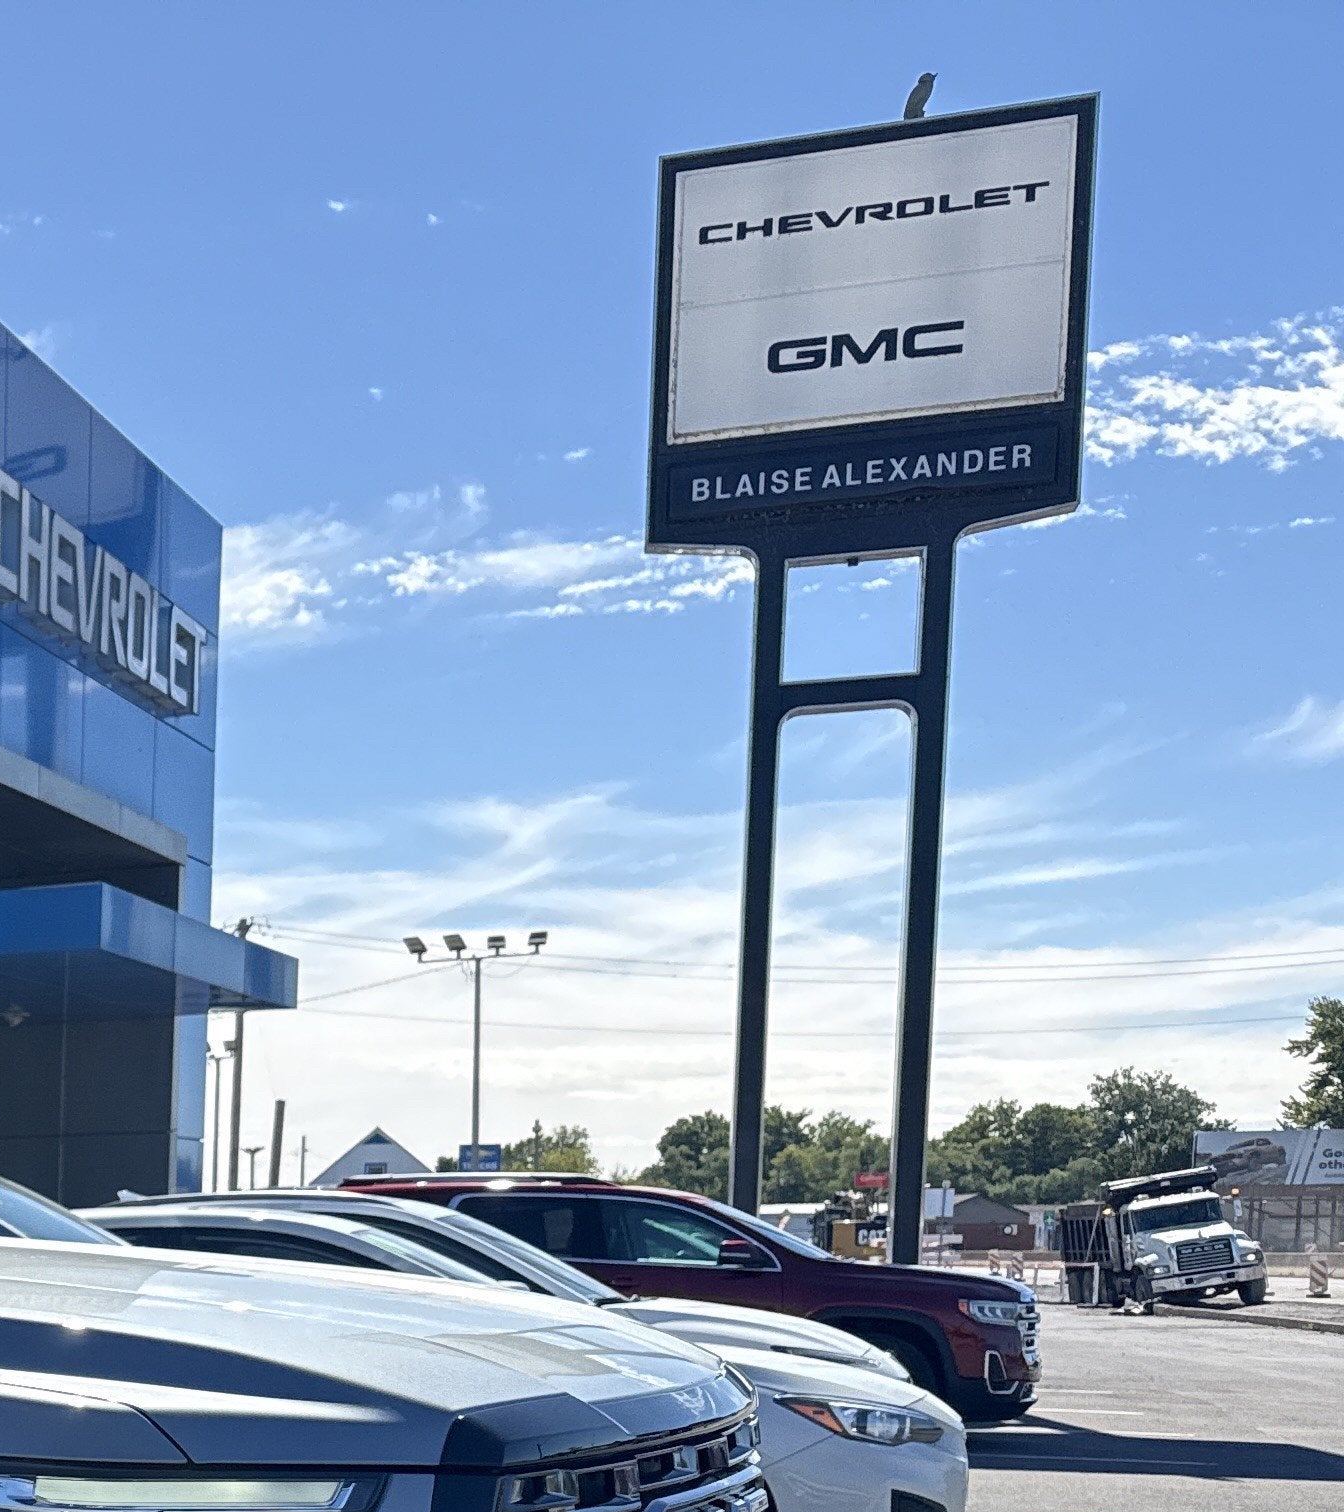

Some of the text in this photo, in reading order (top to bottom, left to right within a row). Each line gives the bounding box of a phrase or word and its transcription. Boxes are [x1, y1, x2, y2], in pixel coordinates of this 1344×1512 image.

[699, 181, 1050, 246] CHEVROLET
[767, 320, 965, 374] GMC
[691, 443, 1033, 503] BLAISE ALEXANDER
[1322, 1148, 1344, 1158] Go
